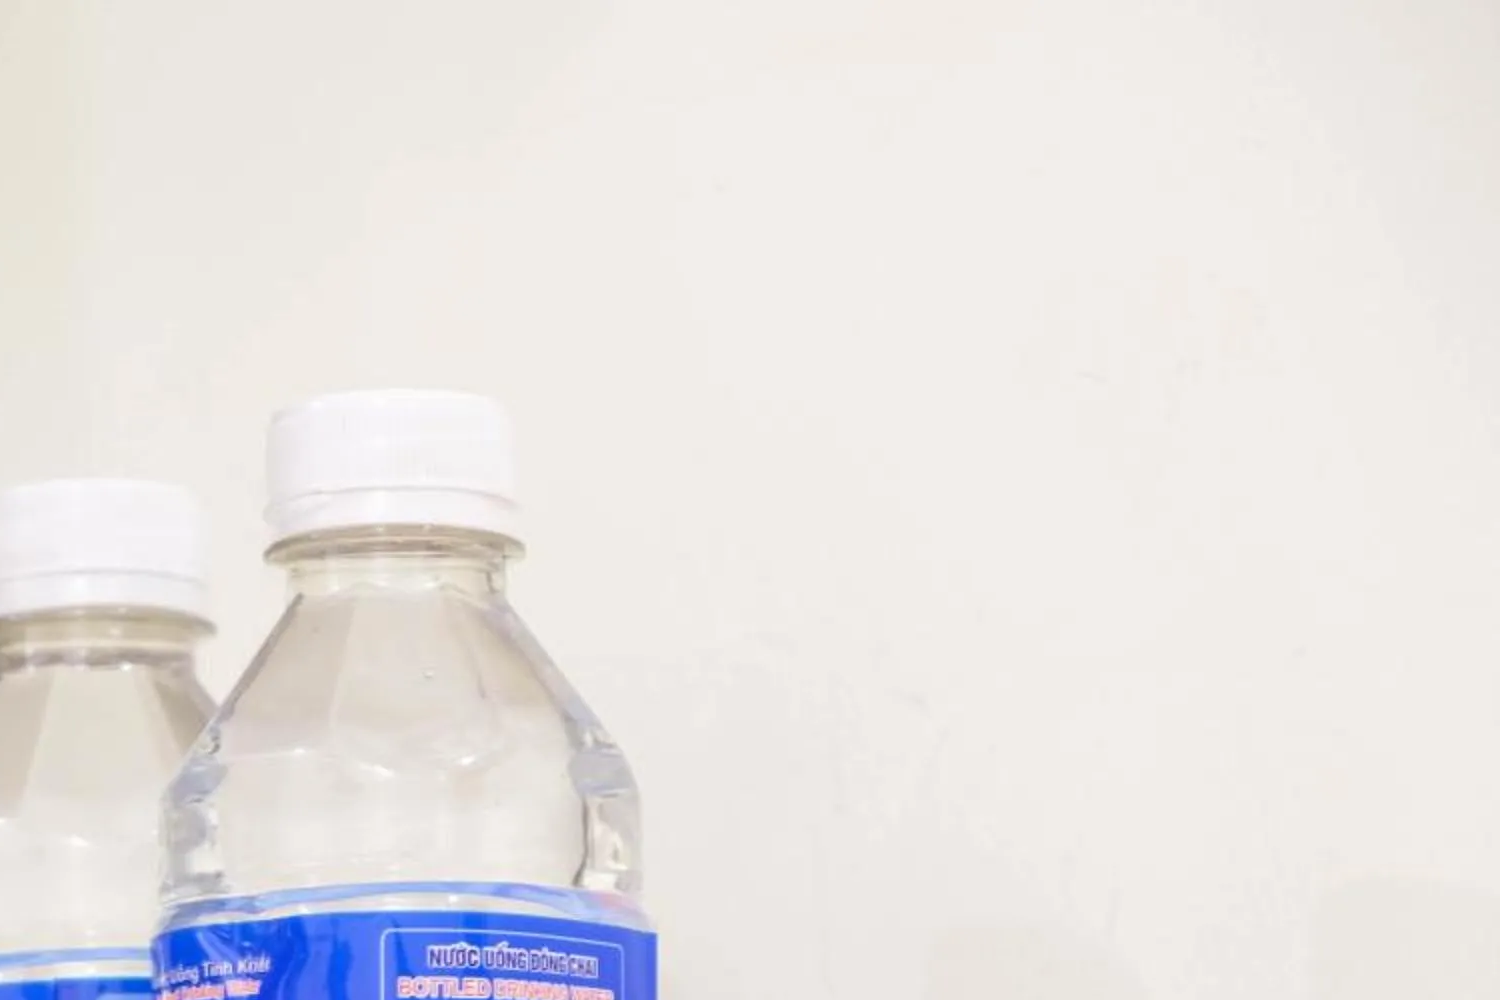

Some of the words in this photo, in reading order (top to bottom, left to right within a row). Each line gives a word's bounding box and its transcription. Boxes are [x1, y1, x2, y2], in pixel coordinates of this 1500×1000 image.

[428, 941, 481, 968] NƯỚC
[483, 941, 527, 971] UỐNG
[397, 976, 492, 999] BOTTLED
